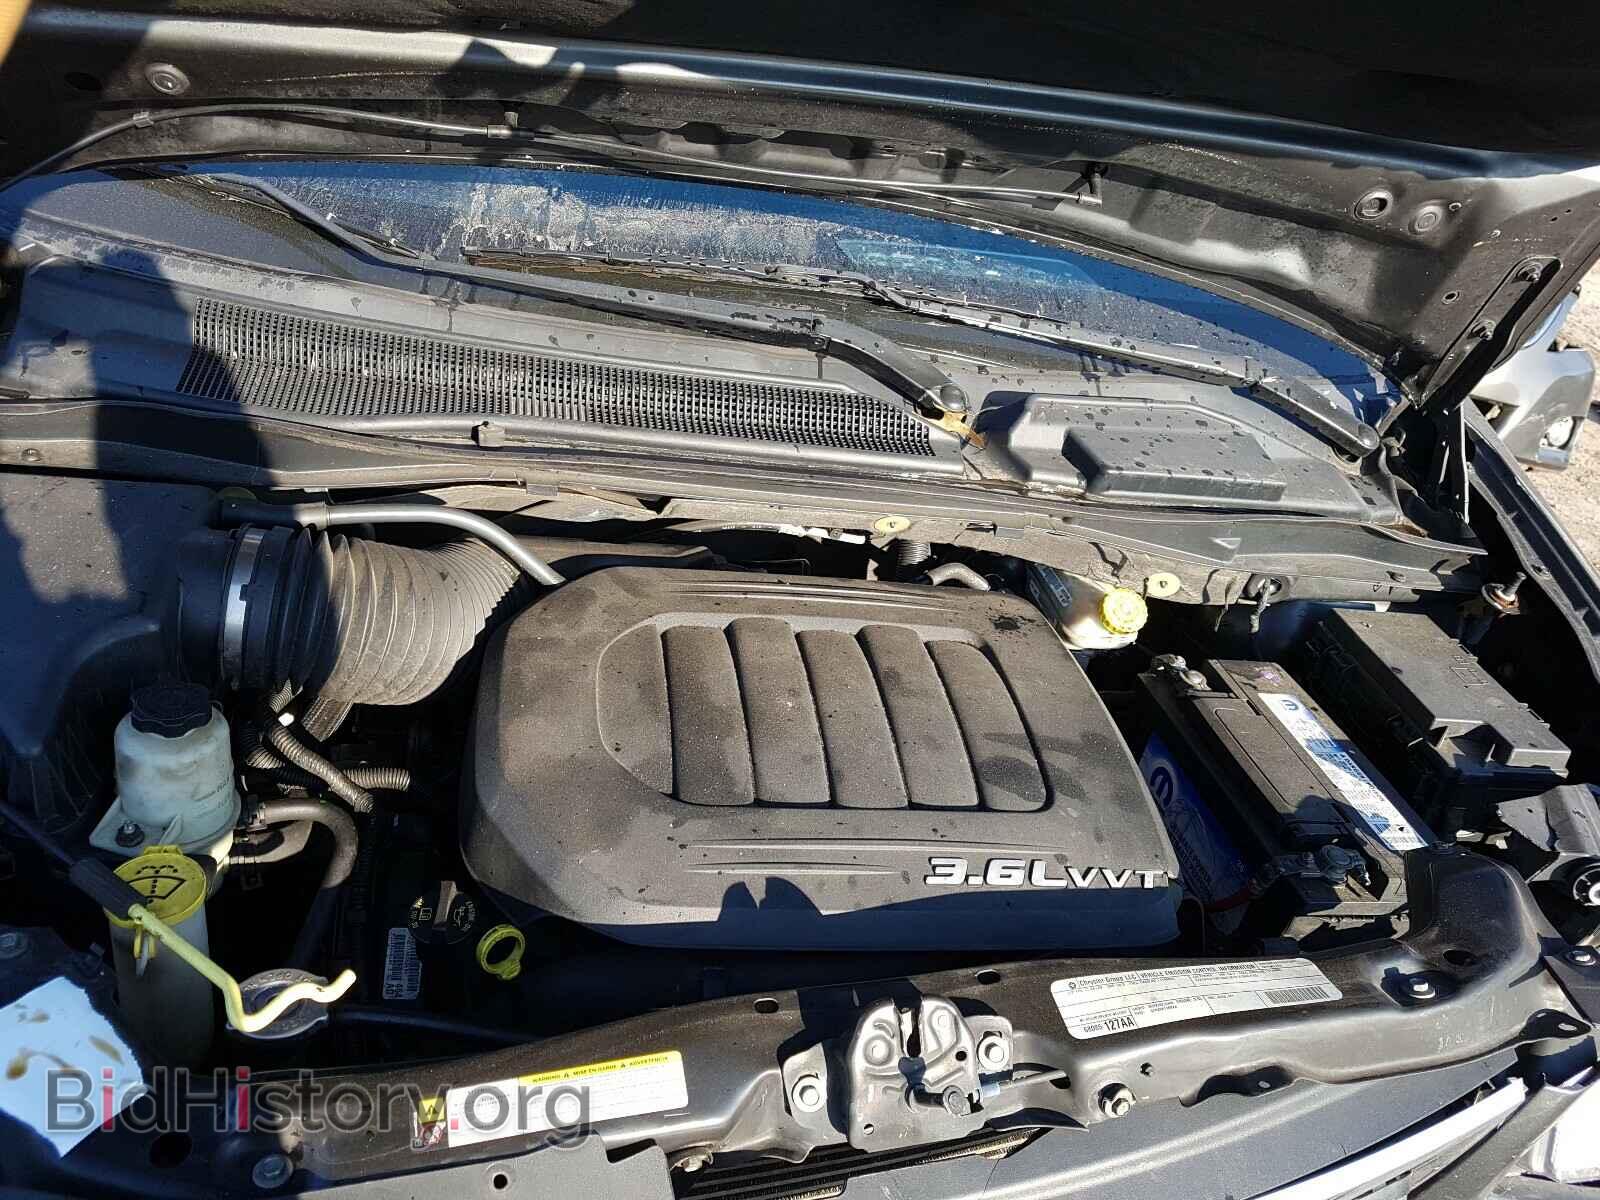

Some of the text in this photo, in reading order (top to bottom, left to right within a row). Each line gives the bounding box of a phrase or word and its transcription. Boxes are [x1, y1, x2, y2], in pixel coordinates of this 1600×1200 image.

[923, 857, 1165, 889] 3.6L VVT
[1140, 971, 1164, 979] VEHICLE
[1164, 968, 1191, 977] EMISSION
[1218, 963, 1256, 972] INFORMATION
[1079, 977, 1105, 987] Chrysler
[1105, 975, 1124, 984] Group
[1123, 973, 1137, 981] LLC
[1104, 1016, 1135, 1032] 127AA
